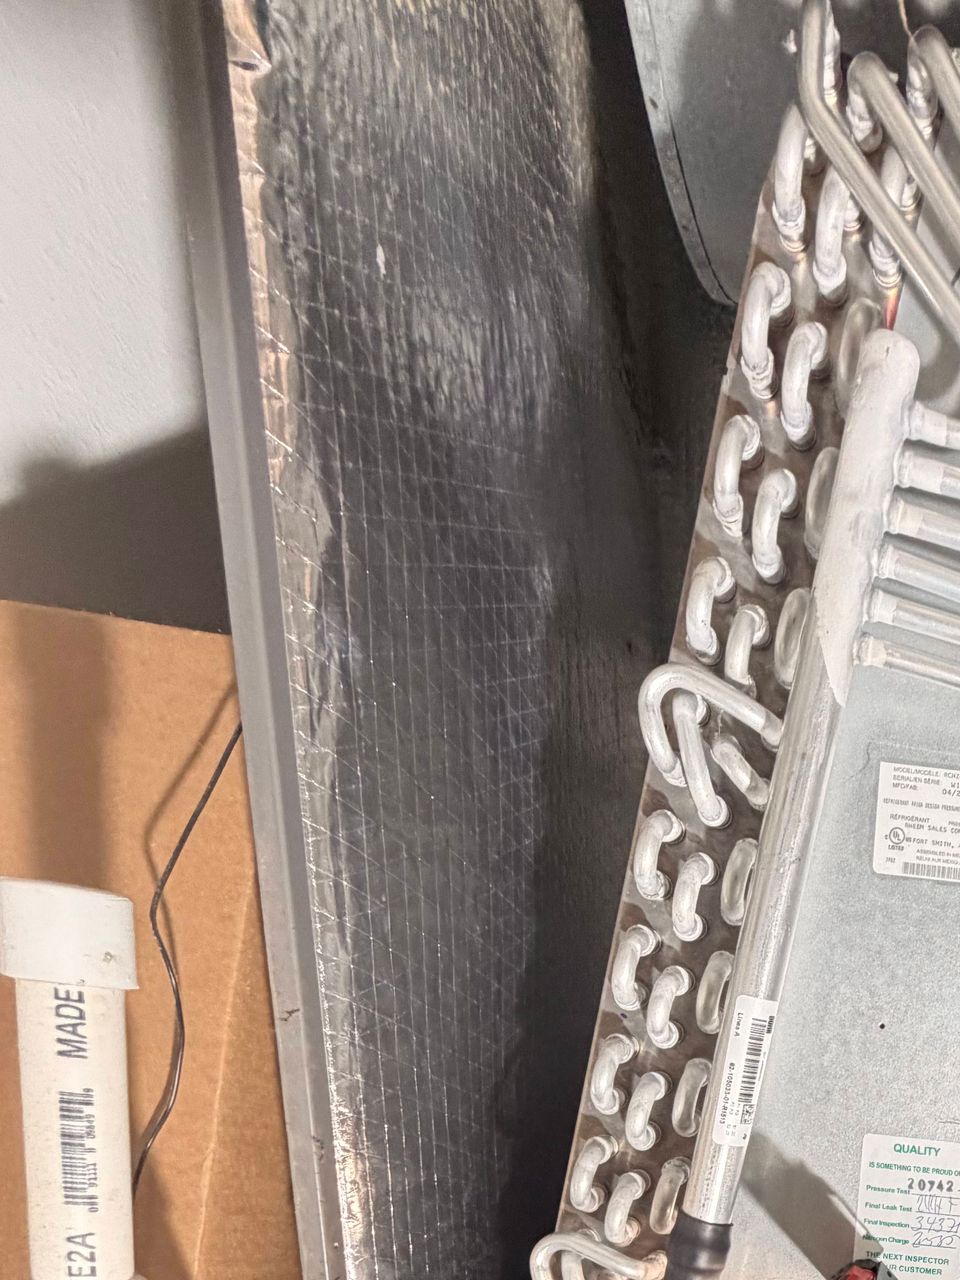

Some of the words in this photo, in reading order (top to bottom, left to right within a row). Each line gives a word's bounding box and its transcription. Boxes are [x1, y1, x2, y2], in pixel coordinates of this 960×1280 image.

[904, 823, 925, 831] RHEEM
[54, 987, 88, 1060] MADE
[893, 1143, 941, 1156] QUALITY
[876, 1162, 912, 1172] SOMETHING
[931, 1168, 953, 1176] PROUD
[866, 1184, 896, 1193] Pressure
[879, 1220, 910, 1229] Inspection
[888, 1237, 910, 1245] Charge
[904, 1255, 950, 1266] INSPECTOR
[898, 1265, 943, 1276] CUSTOMER
